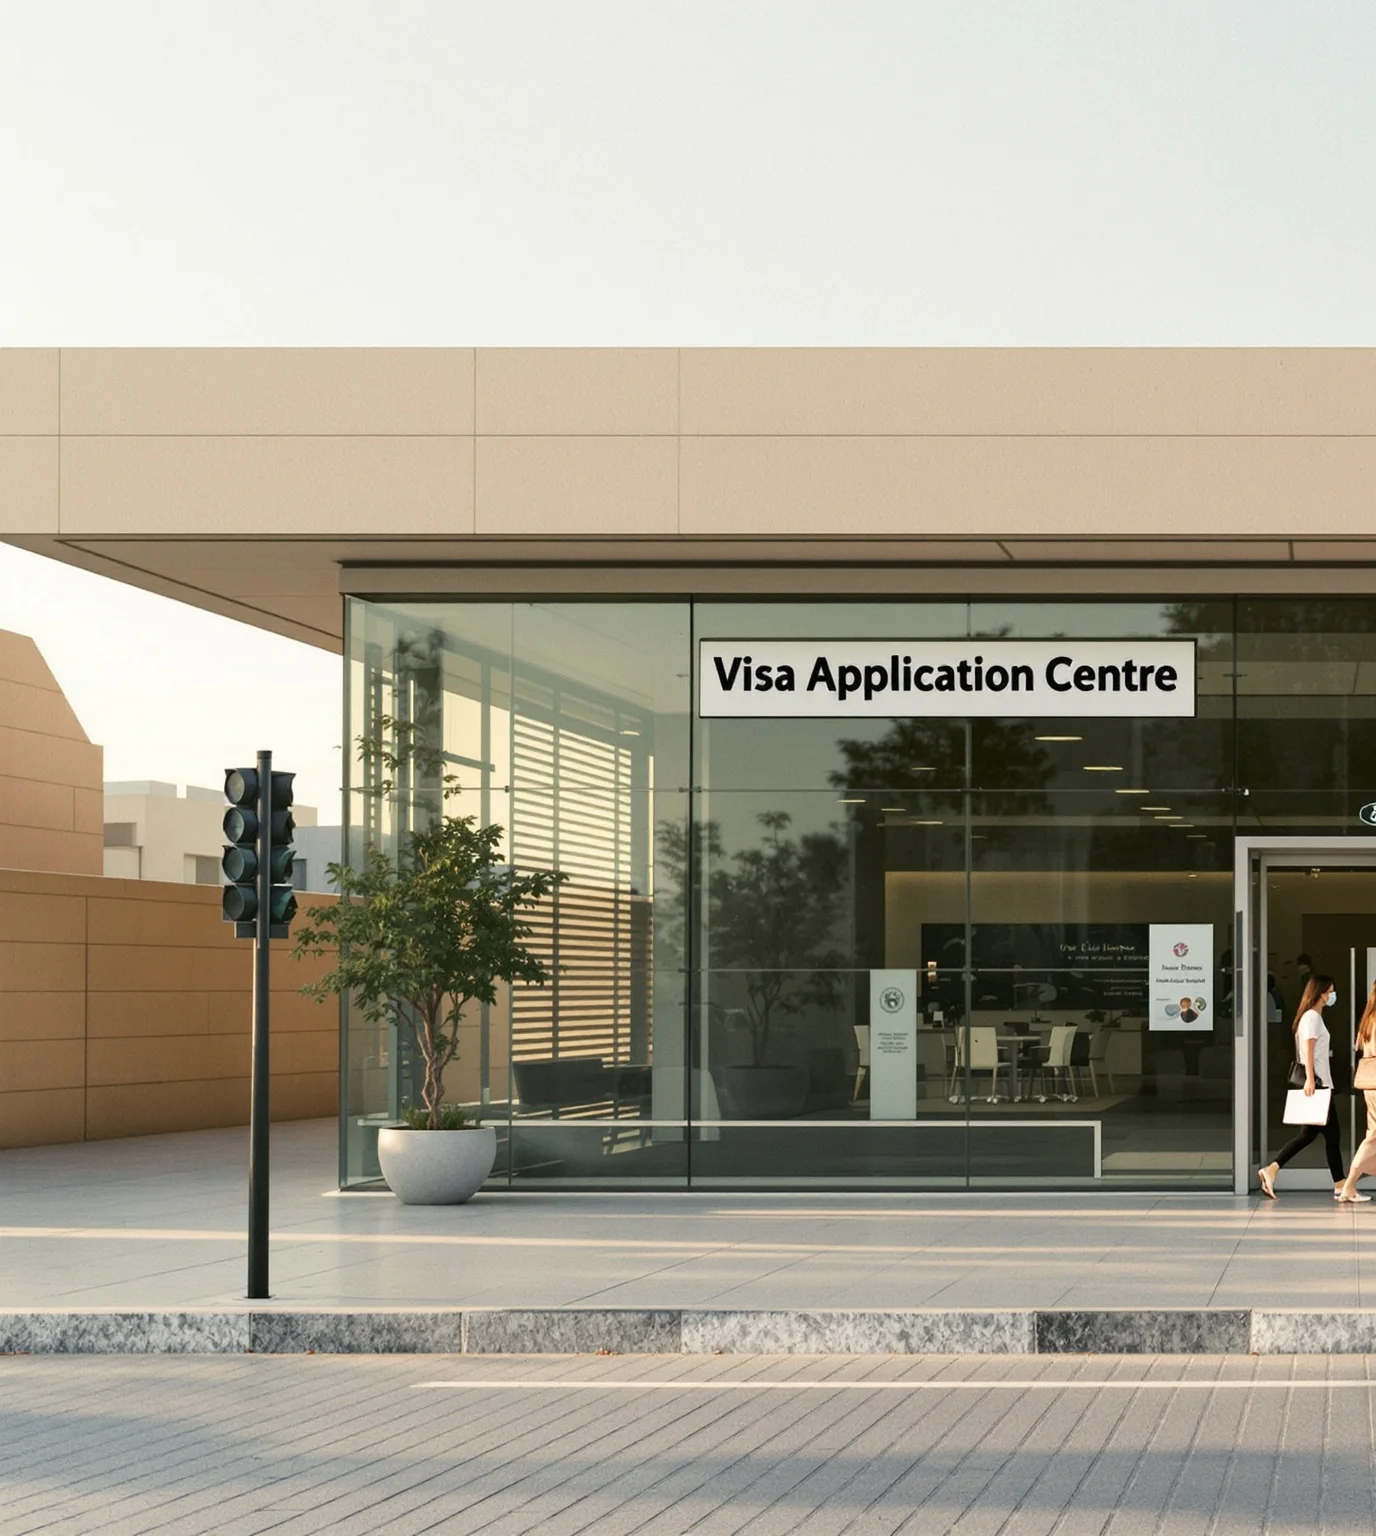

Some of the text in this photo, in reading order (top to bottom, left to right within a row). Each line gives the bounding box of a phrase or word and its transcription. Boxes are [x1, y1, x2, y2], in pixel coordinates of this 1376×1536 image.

[714, 655, 1177, 700] Visa Application Centre
